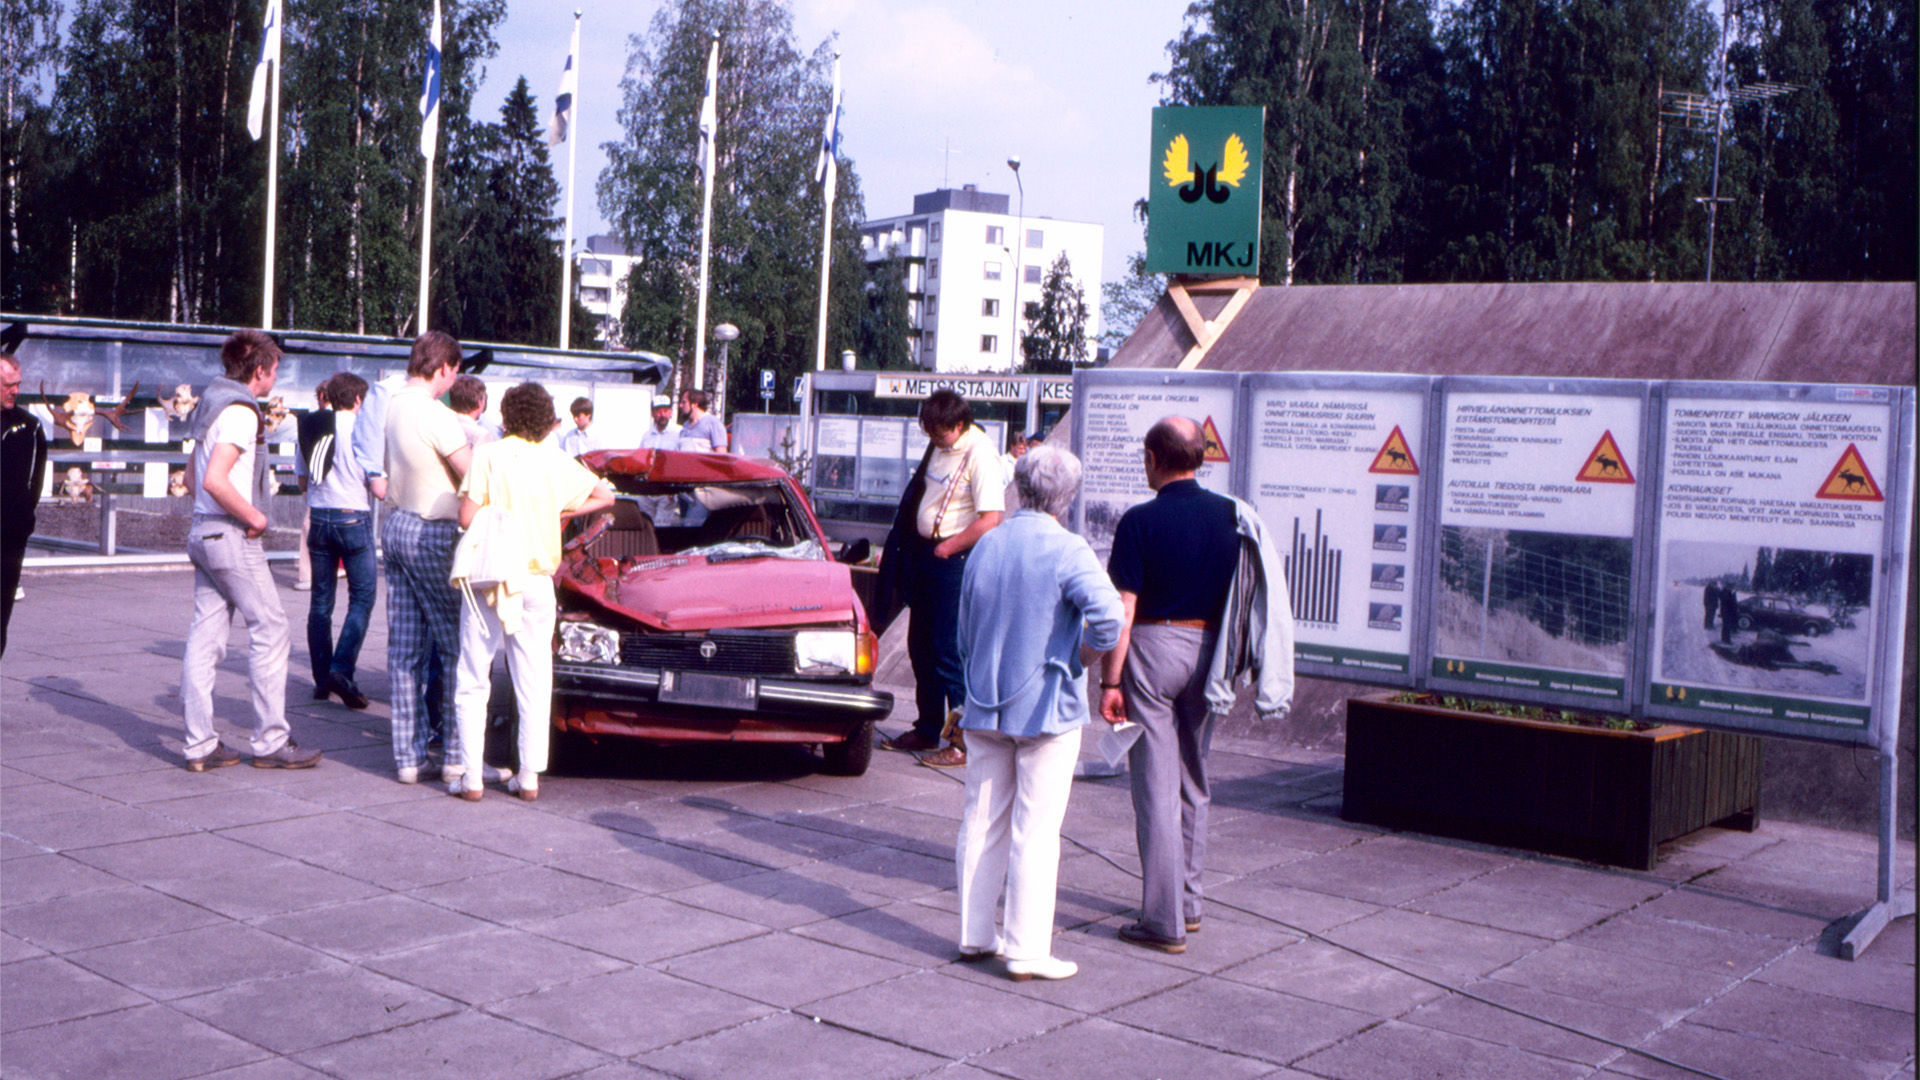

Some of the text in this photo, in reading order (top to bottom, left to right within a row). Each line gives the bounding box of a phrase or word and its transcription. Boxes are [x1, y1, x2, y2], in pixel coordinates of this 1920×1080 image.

[1187, 242, 1254, 267] MKJ
[763, 371, 773, 388] P
[1042, 382, 1073, 399] KES
[1674, 409, 1851, 423] TOIMENPITEET VAHINGON JÄLKEEN
[1668, 484, 1733, 495] KORVAUKSET
